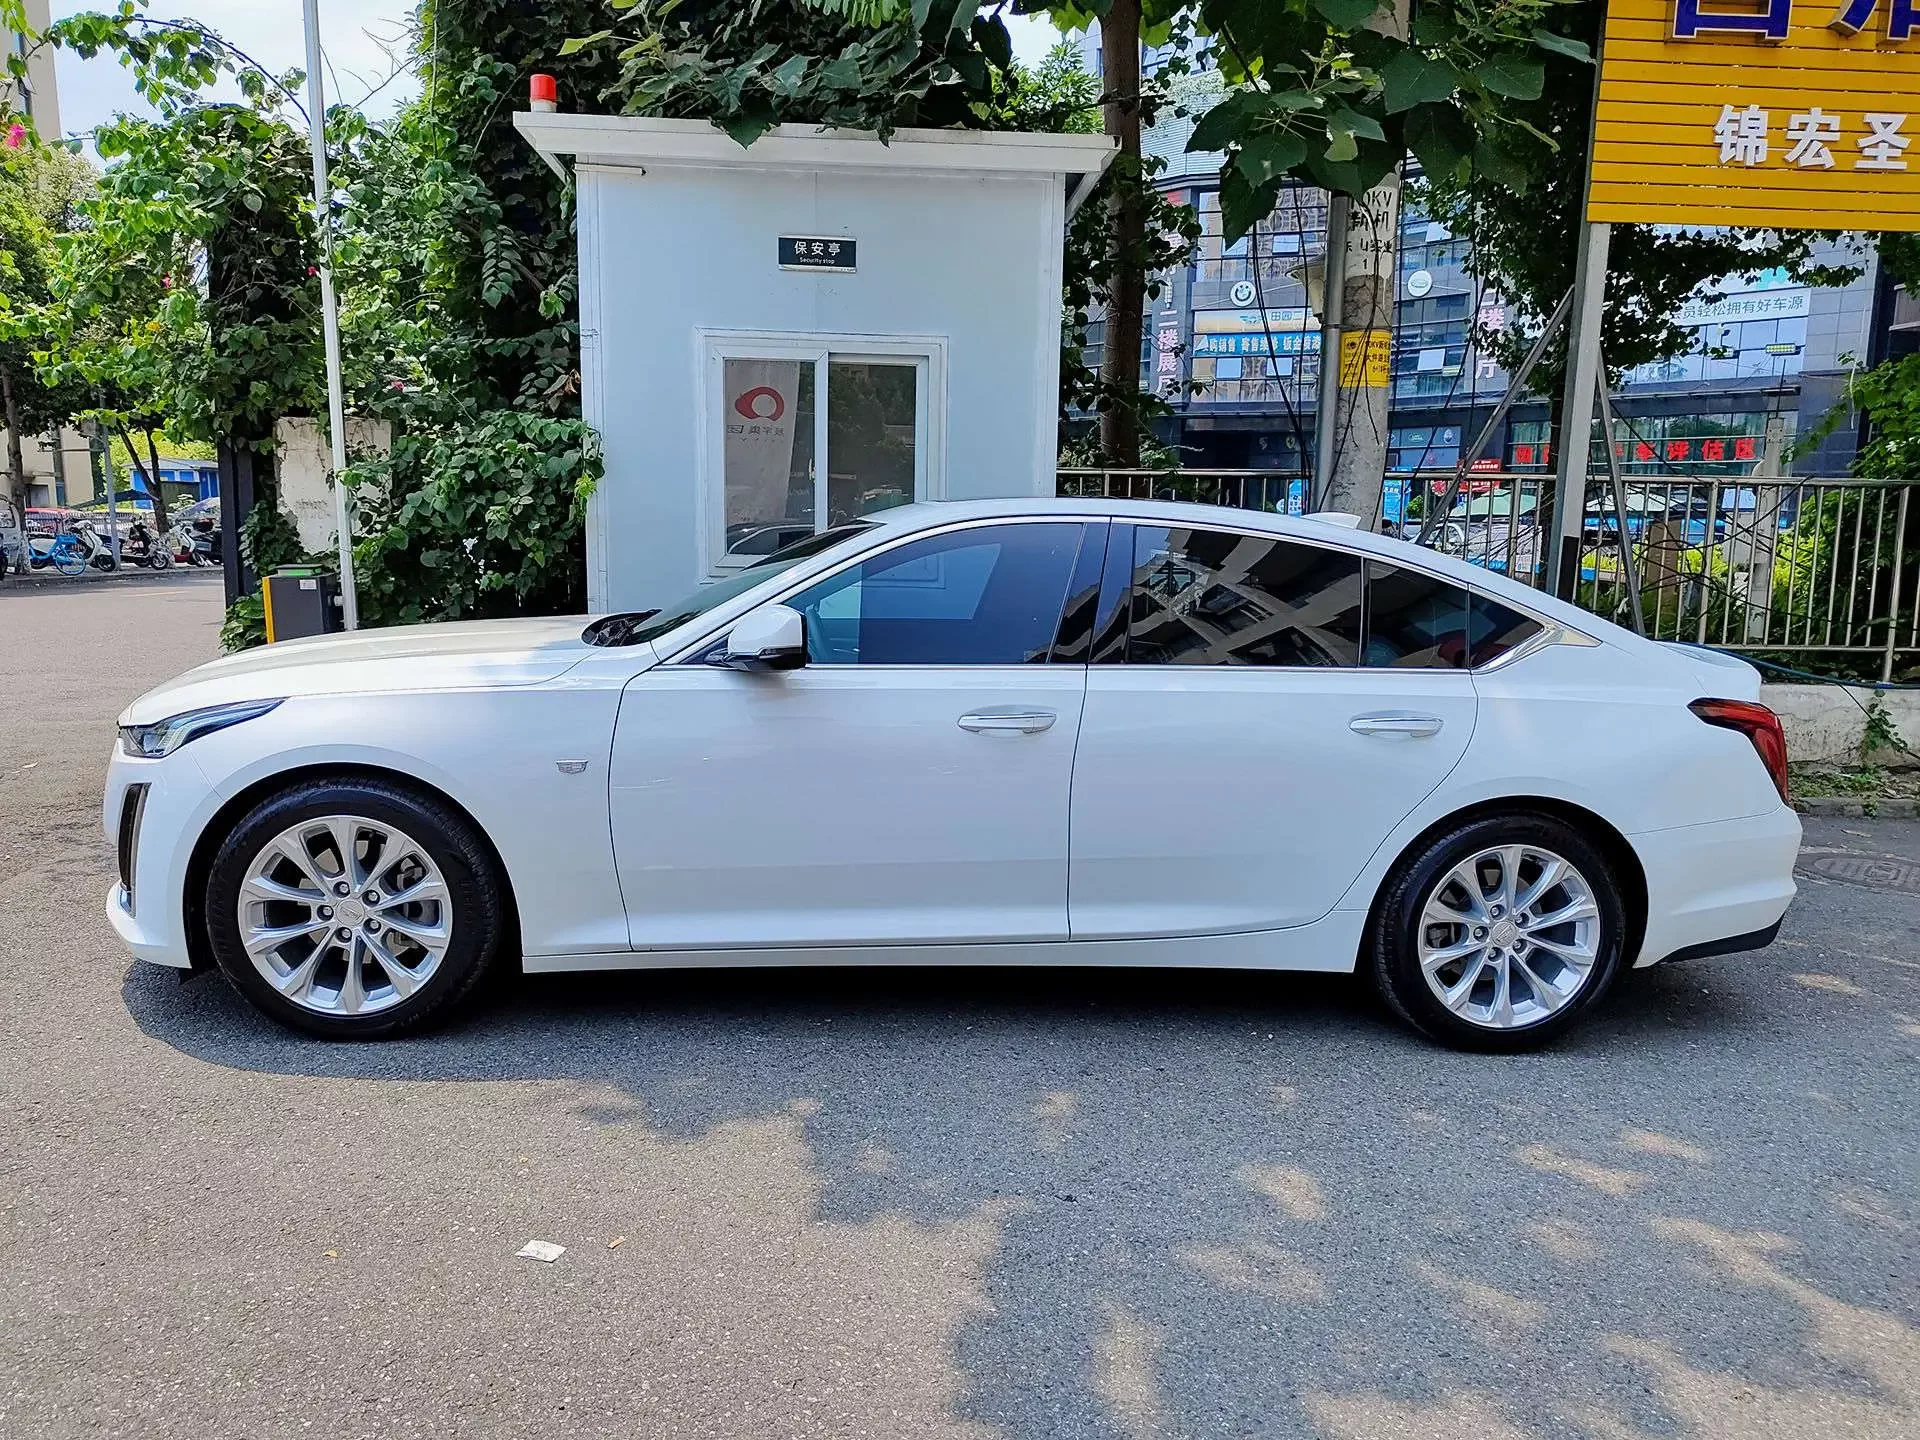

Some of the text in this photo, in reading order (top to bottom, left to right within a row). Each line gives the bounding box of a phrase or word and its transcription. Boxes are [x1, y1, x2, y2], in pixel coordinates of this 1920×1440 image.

[1713, 104, 1912, 171] 锦宏圣
[794, 240, 841, 256] 保安亭
[800, 256, 822, 264] Security
[1202, 338, 1236, 352] 购销售
